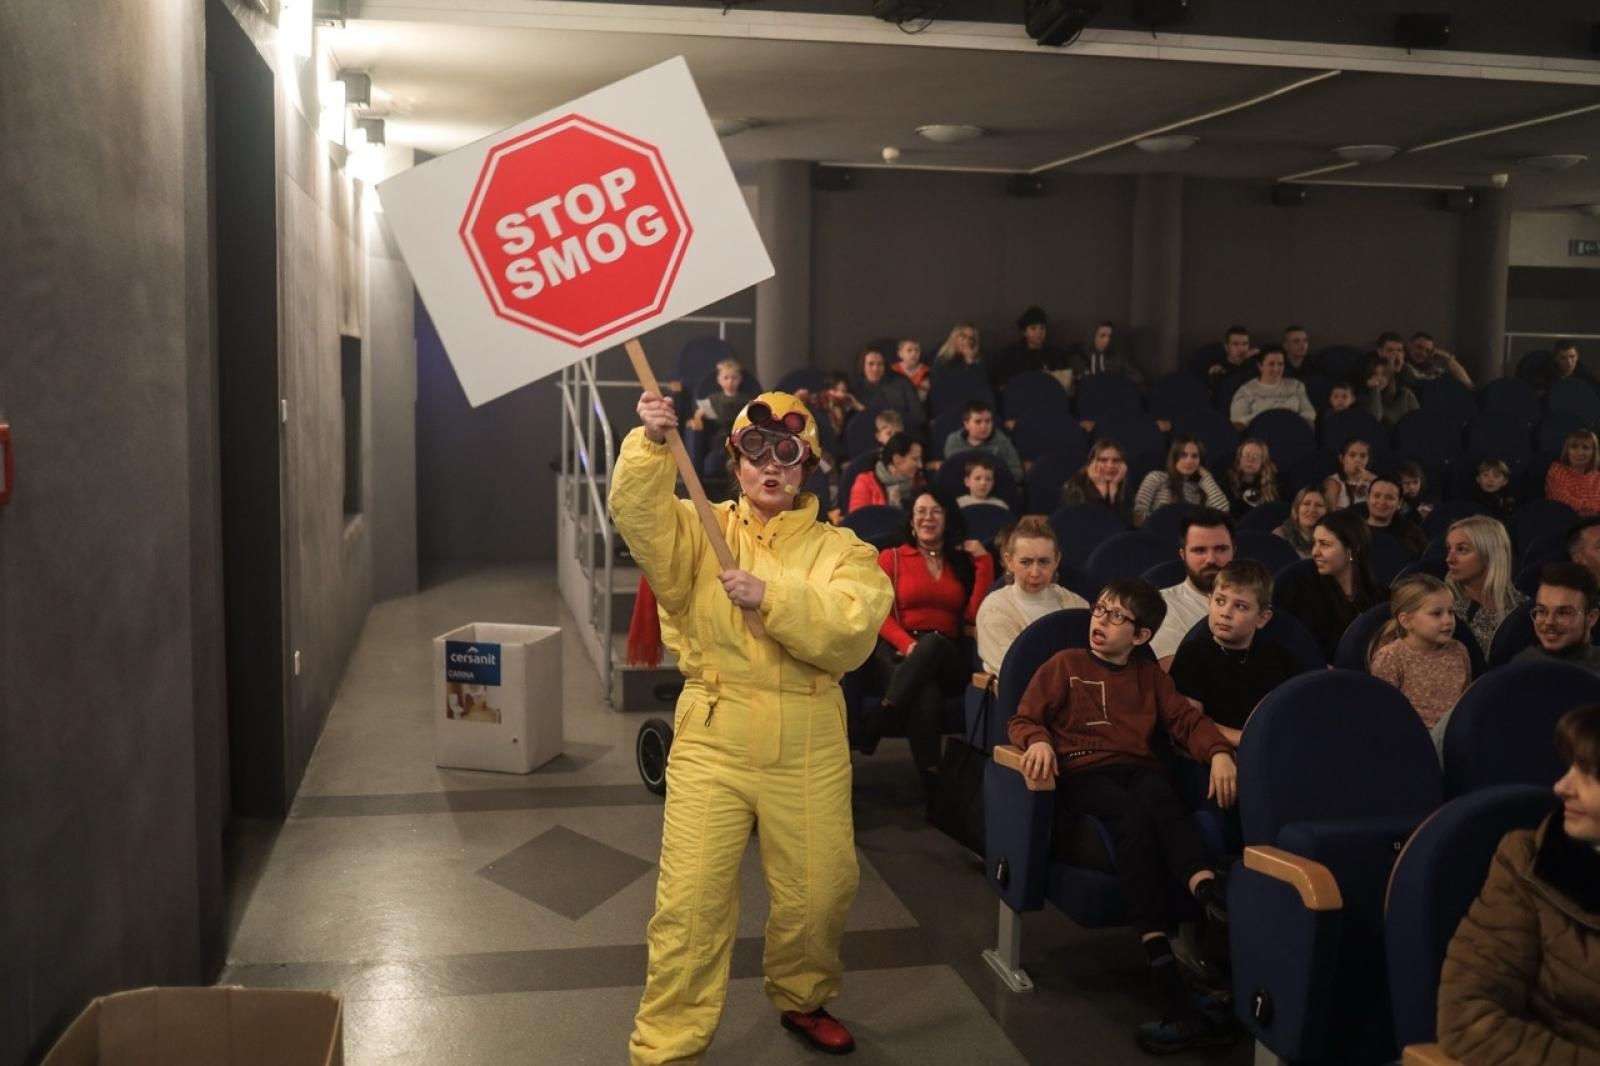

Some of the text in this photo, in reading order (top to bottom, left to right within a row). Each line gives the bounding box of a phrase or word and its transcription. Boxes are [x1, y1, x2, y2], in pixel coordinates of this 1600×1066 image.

[495, 167, 636, 255] STOP
[505, 204, 668, 300] SMOG
[450, 653, 496, 665] cersanit
